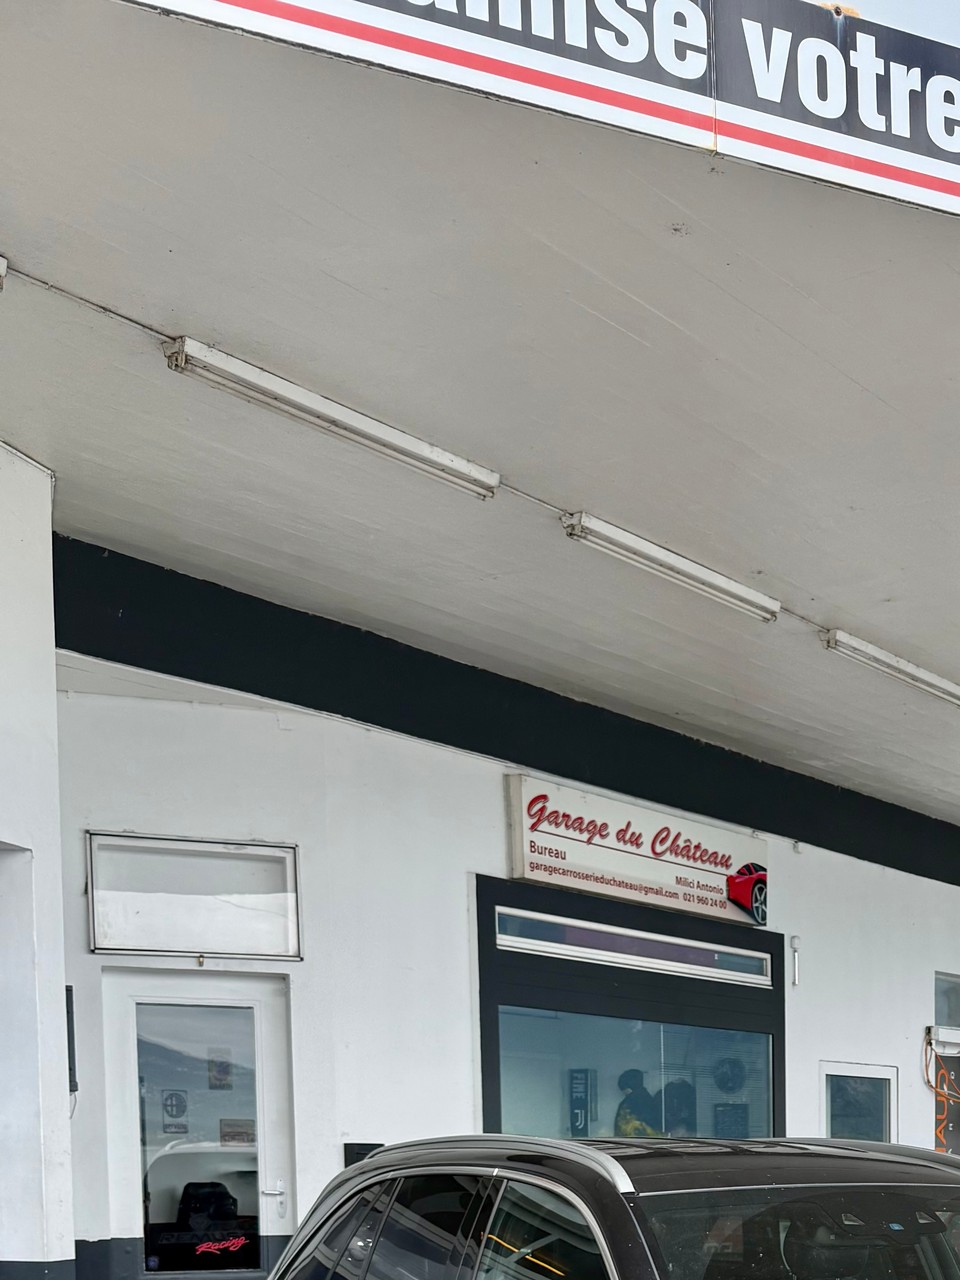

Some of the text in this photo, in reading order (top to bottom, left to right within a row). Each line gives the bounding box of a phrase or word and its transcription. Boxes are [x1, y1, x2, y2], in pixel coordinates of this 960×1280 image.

[526, 793, 733, 871] Garage du Château
[529, 840, 567, 861] Bureau
[529, 861, 728, 910] garagecarrosserieduchateau@gmail.com 021 960 24 00
[696, 880, 724, 896] Antonio
[195, 1236, 250, 1255] Racing
